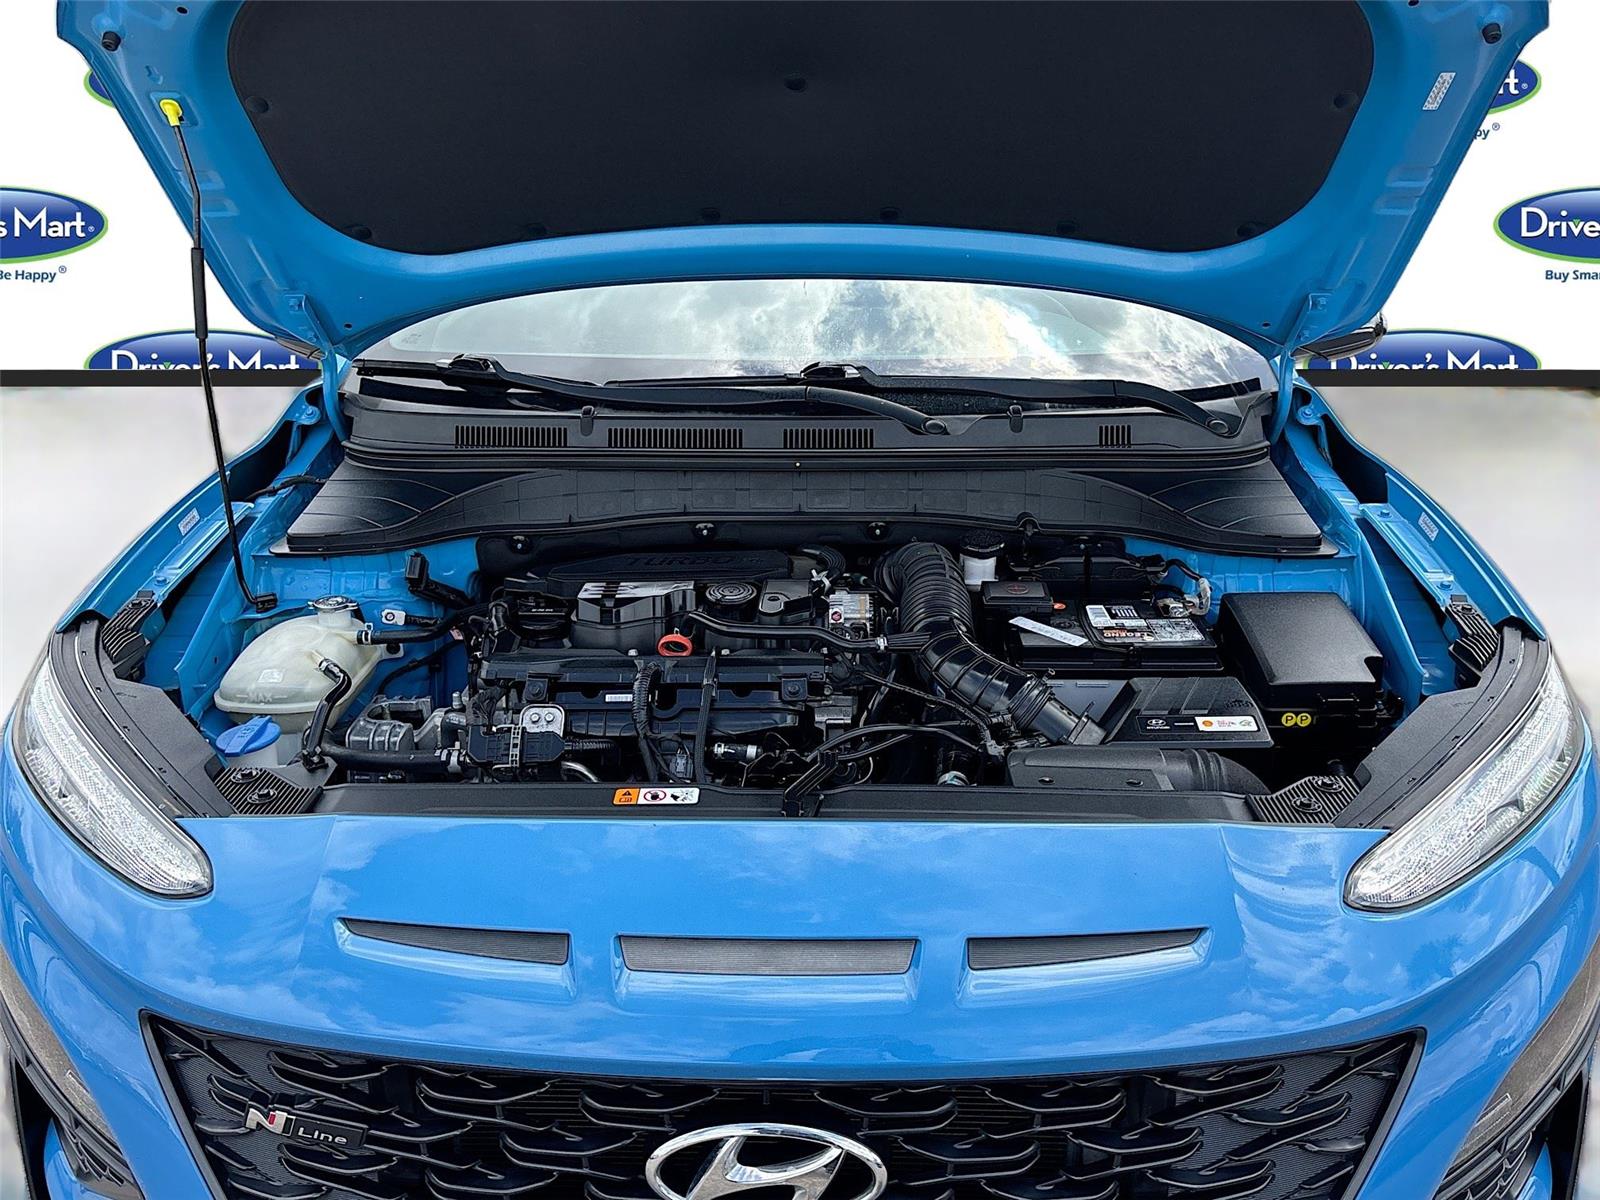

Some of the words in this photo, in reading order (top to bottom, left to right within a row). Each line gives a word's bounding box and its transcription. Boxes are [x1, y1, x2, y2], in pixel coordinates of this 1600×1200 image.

[14, 206, 86, 238] Mart
[15, 269, 57, 283] Happy
[1545, 269, 1570, 283] Buy
[1572, 269, 1600, 281] Sma
[249, 690, 273, 703] MAX
